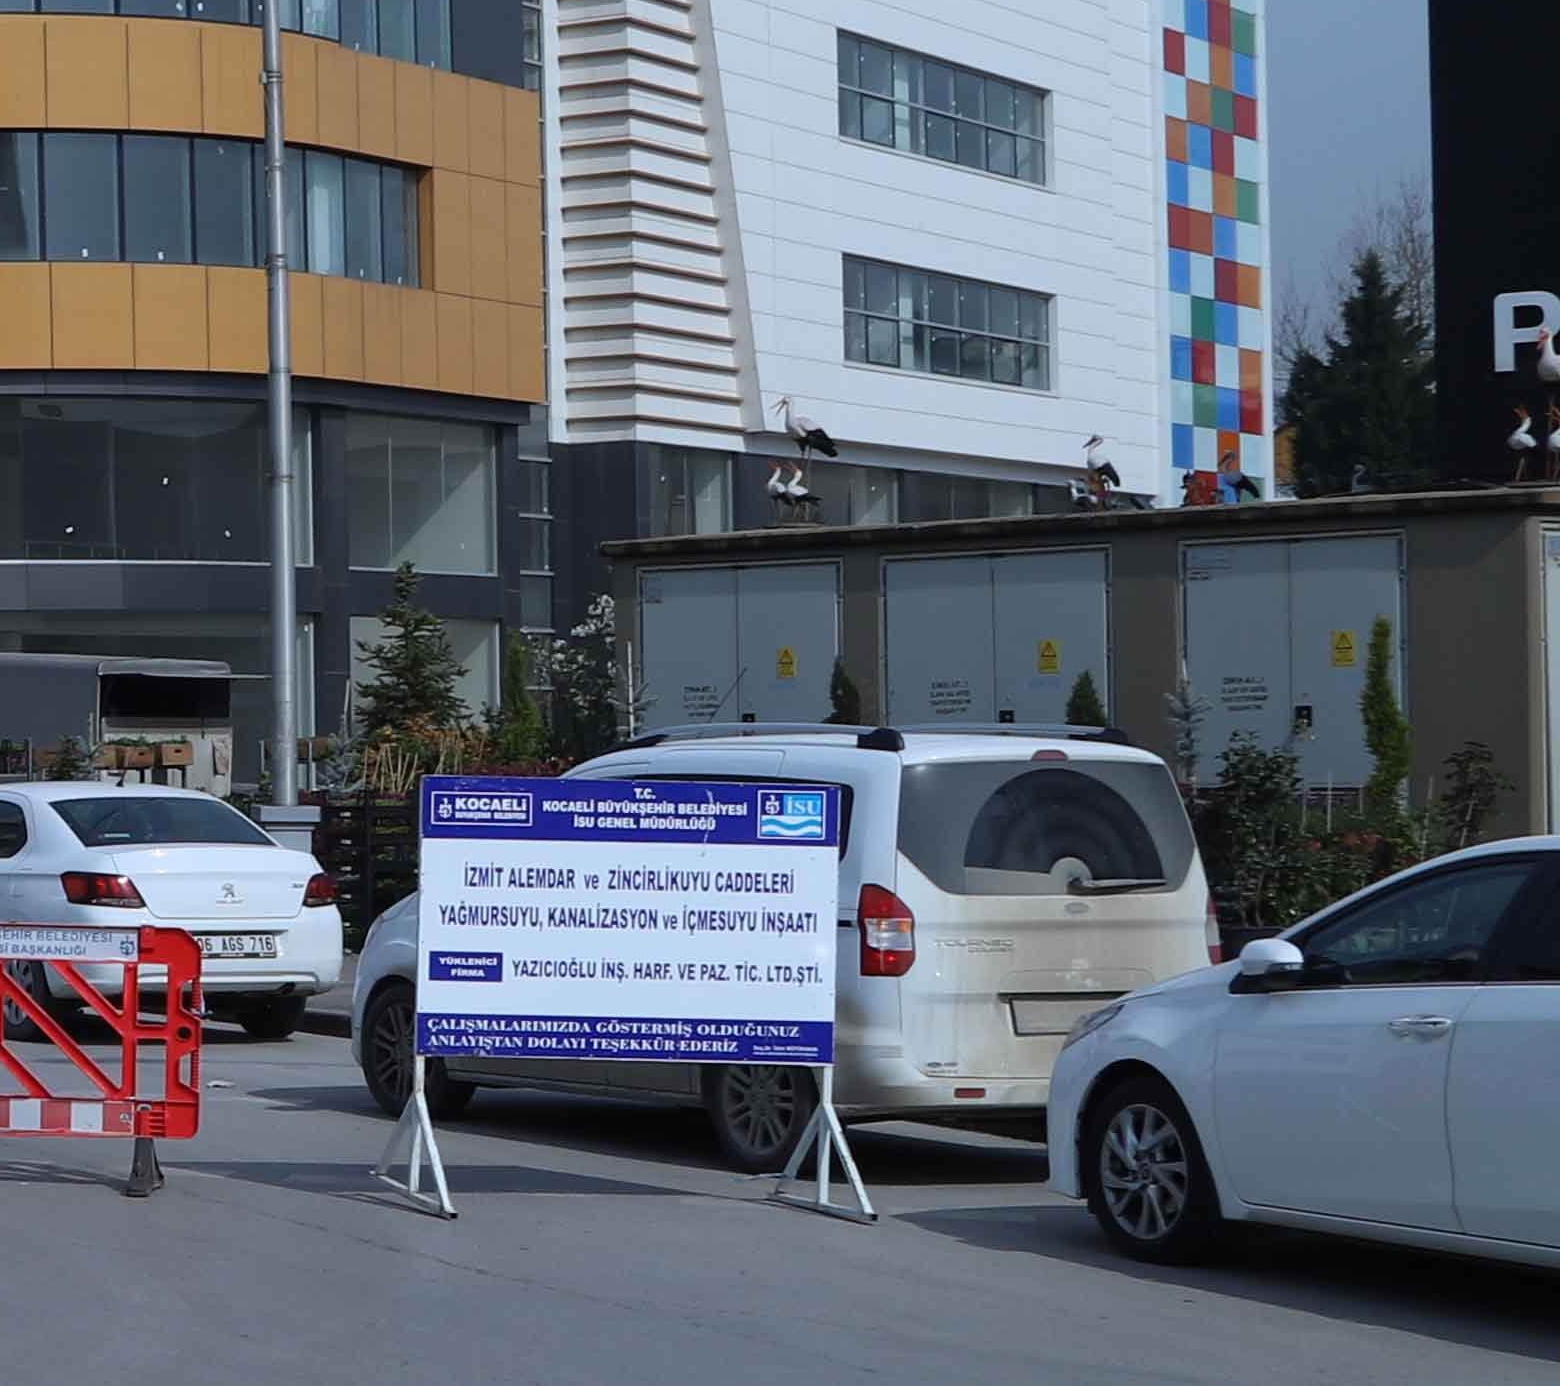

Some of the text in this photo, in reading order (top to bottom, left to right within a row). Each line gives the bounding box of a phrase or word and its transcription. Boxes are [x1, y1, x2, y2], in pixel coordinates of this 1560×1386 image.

[634, 788, 656, 799] T.C.
[455, 797, 527, 811] KOCAELİ
[542, 799, 748, 816] KOCAELİ BÜYÜKŞEHİR BELEDİYESİ
[788, 796, 821, 814] İSU
[574, 814, 716, 830] İSU GENEL MÜDÜRLÜĞÜ
[464, 861, 795, 894] İZMİT ALEMDAR ve ZİNCİRLİKUYU CADDELERİ
[439, 901, 817, 938] YAĞMURSUYU, KANALİZASYON ve İÇMESUYU İNŞAATI
[36, 930, 113, 944] BELEDİYESİ
[197, 937, 273, 951] 06 AGS 716
[12, 944, 87, 956] BAŞKANLIĞI
[439, 956, 498, 966] YÜKLENİCİ
[451, 968, 485, 977] FİRMA
[512, 957, 597, 979] YAZICIOĞLU
[601, 958, 629, 983] İNŞ.
[633, 962, 672, 981] HARF.
[678, 964, 696, 981] VE
[700, 964, 730, 982] PAZ.
[736, 960, 762, 982] TİC.
[427, 1018, 800, 1038] ÇALIŞMALARIMIZDA GÖSTERMİŞ OLDUĞUNUZ
[428, 1035, 523, 1049] ANLAYIŞTAN
[528, 1036, 586, 1049] DOLAYI
[590, 1037, 675, 1053] TEŞEKKÜR
[679, 1038, 739, 1053] EDERİZ
